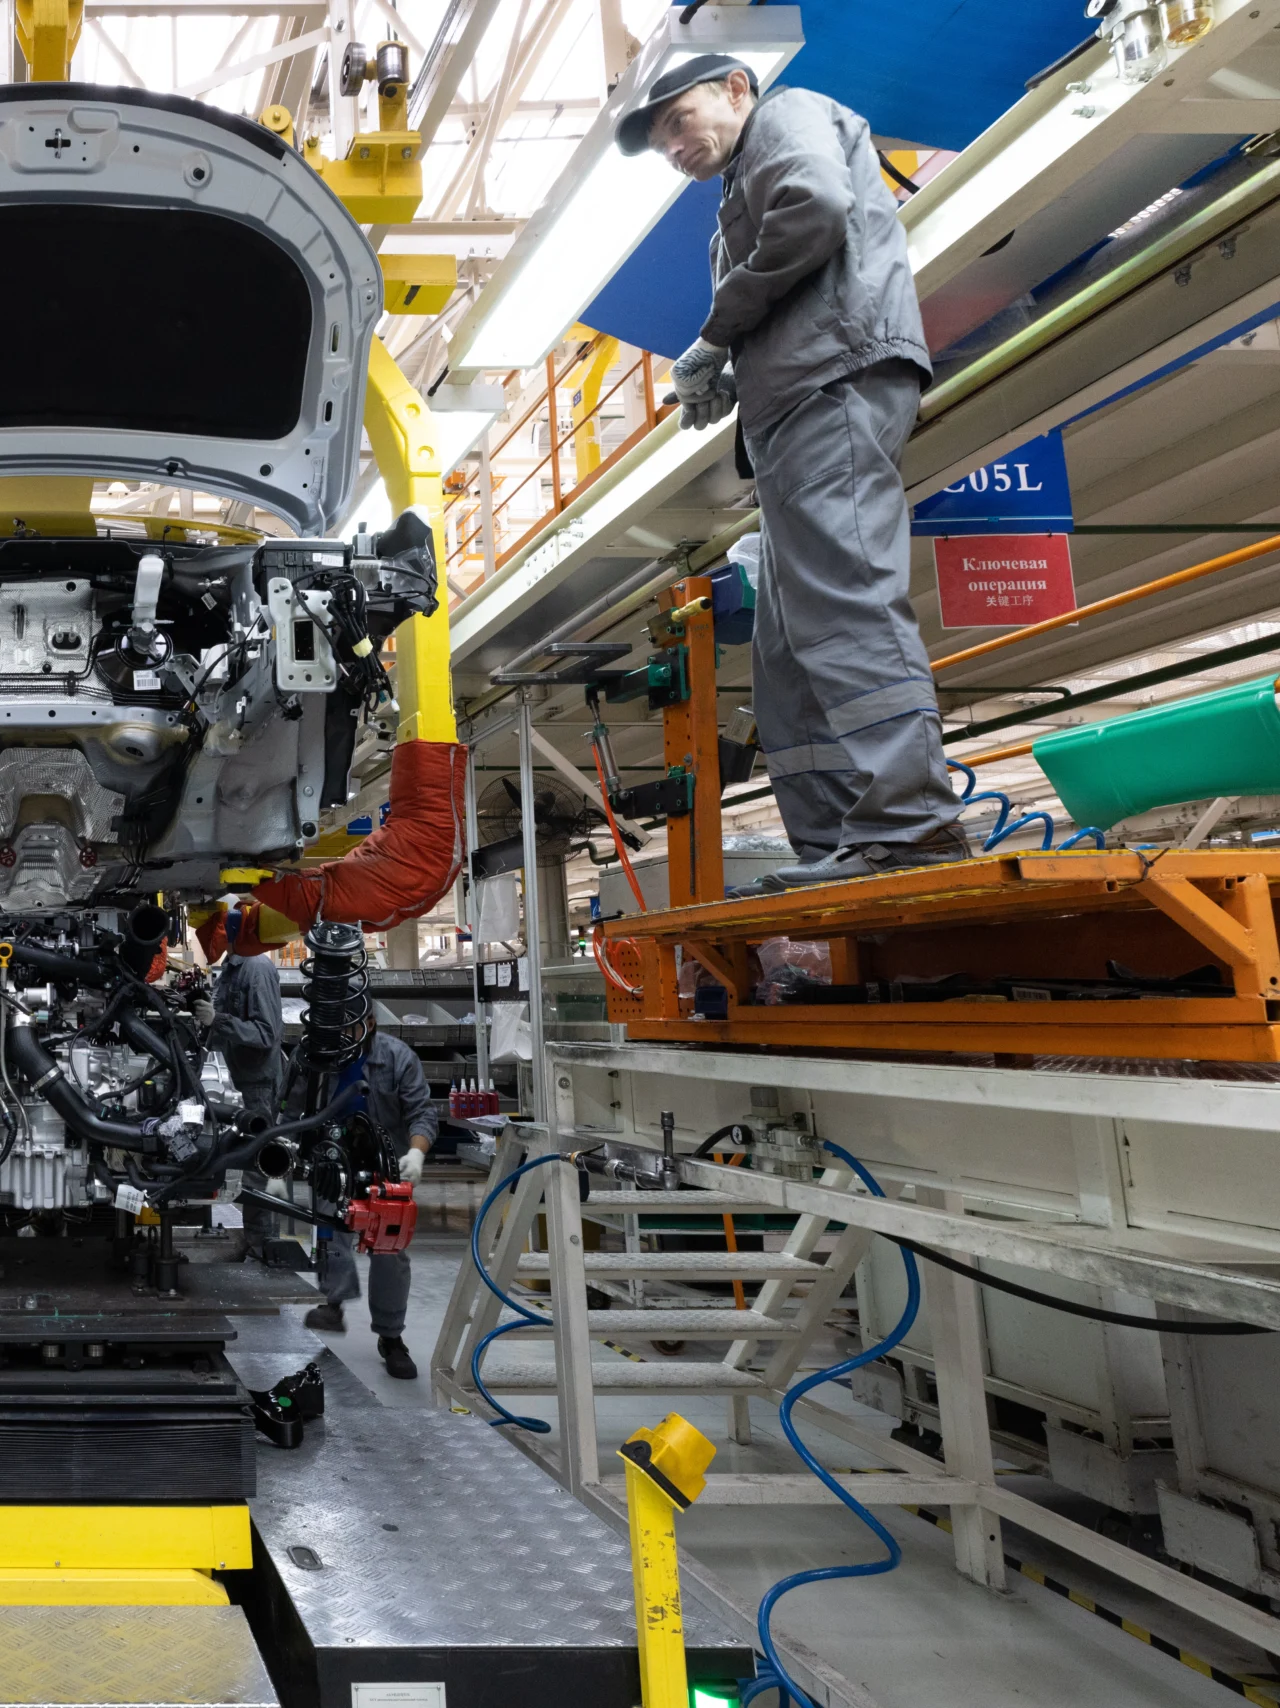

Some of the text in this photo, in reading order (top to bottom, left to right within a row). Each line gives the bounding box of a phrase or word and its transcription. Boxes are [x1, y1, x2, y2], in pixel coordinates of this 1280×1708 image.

[962, 557, 1048, 571] Ключевая
[968, 580, 1048, 594] операция
[986, 595, 1034, 607] 关键工序
